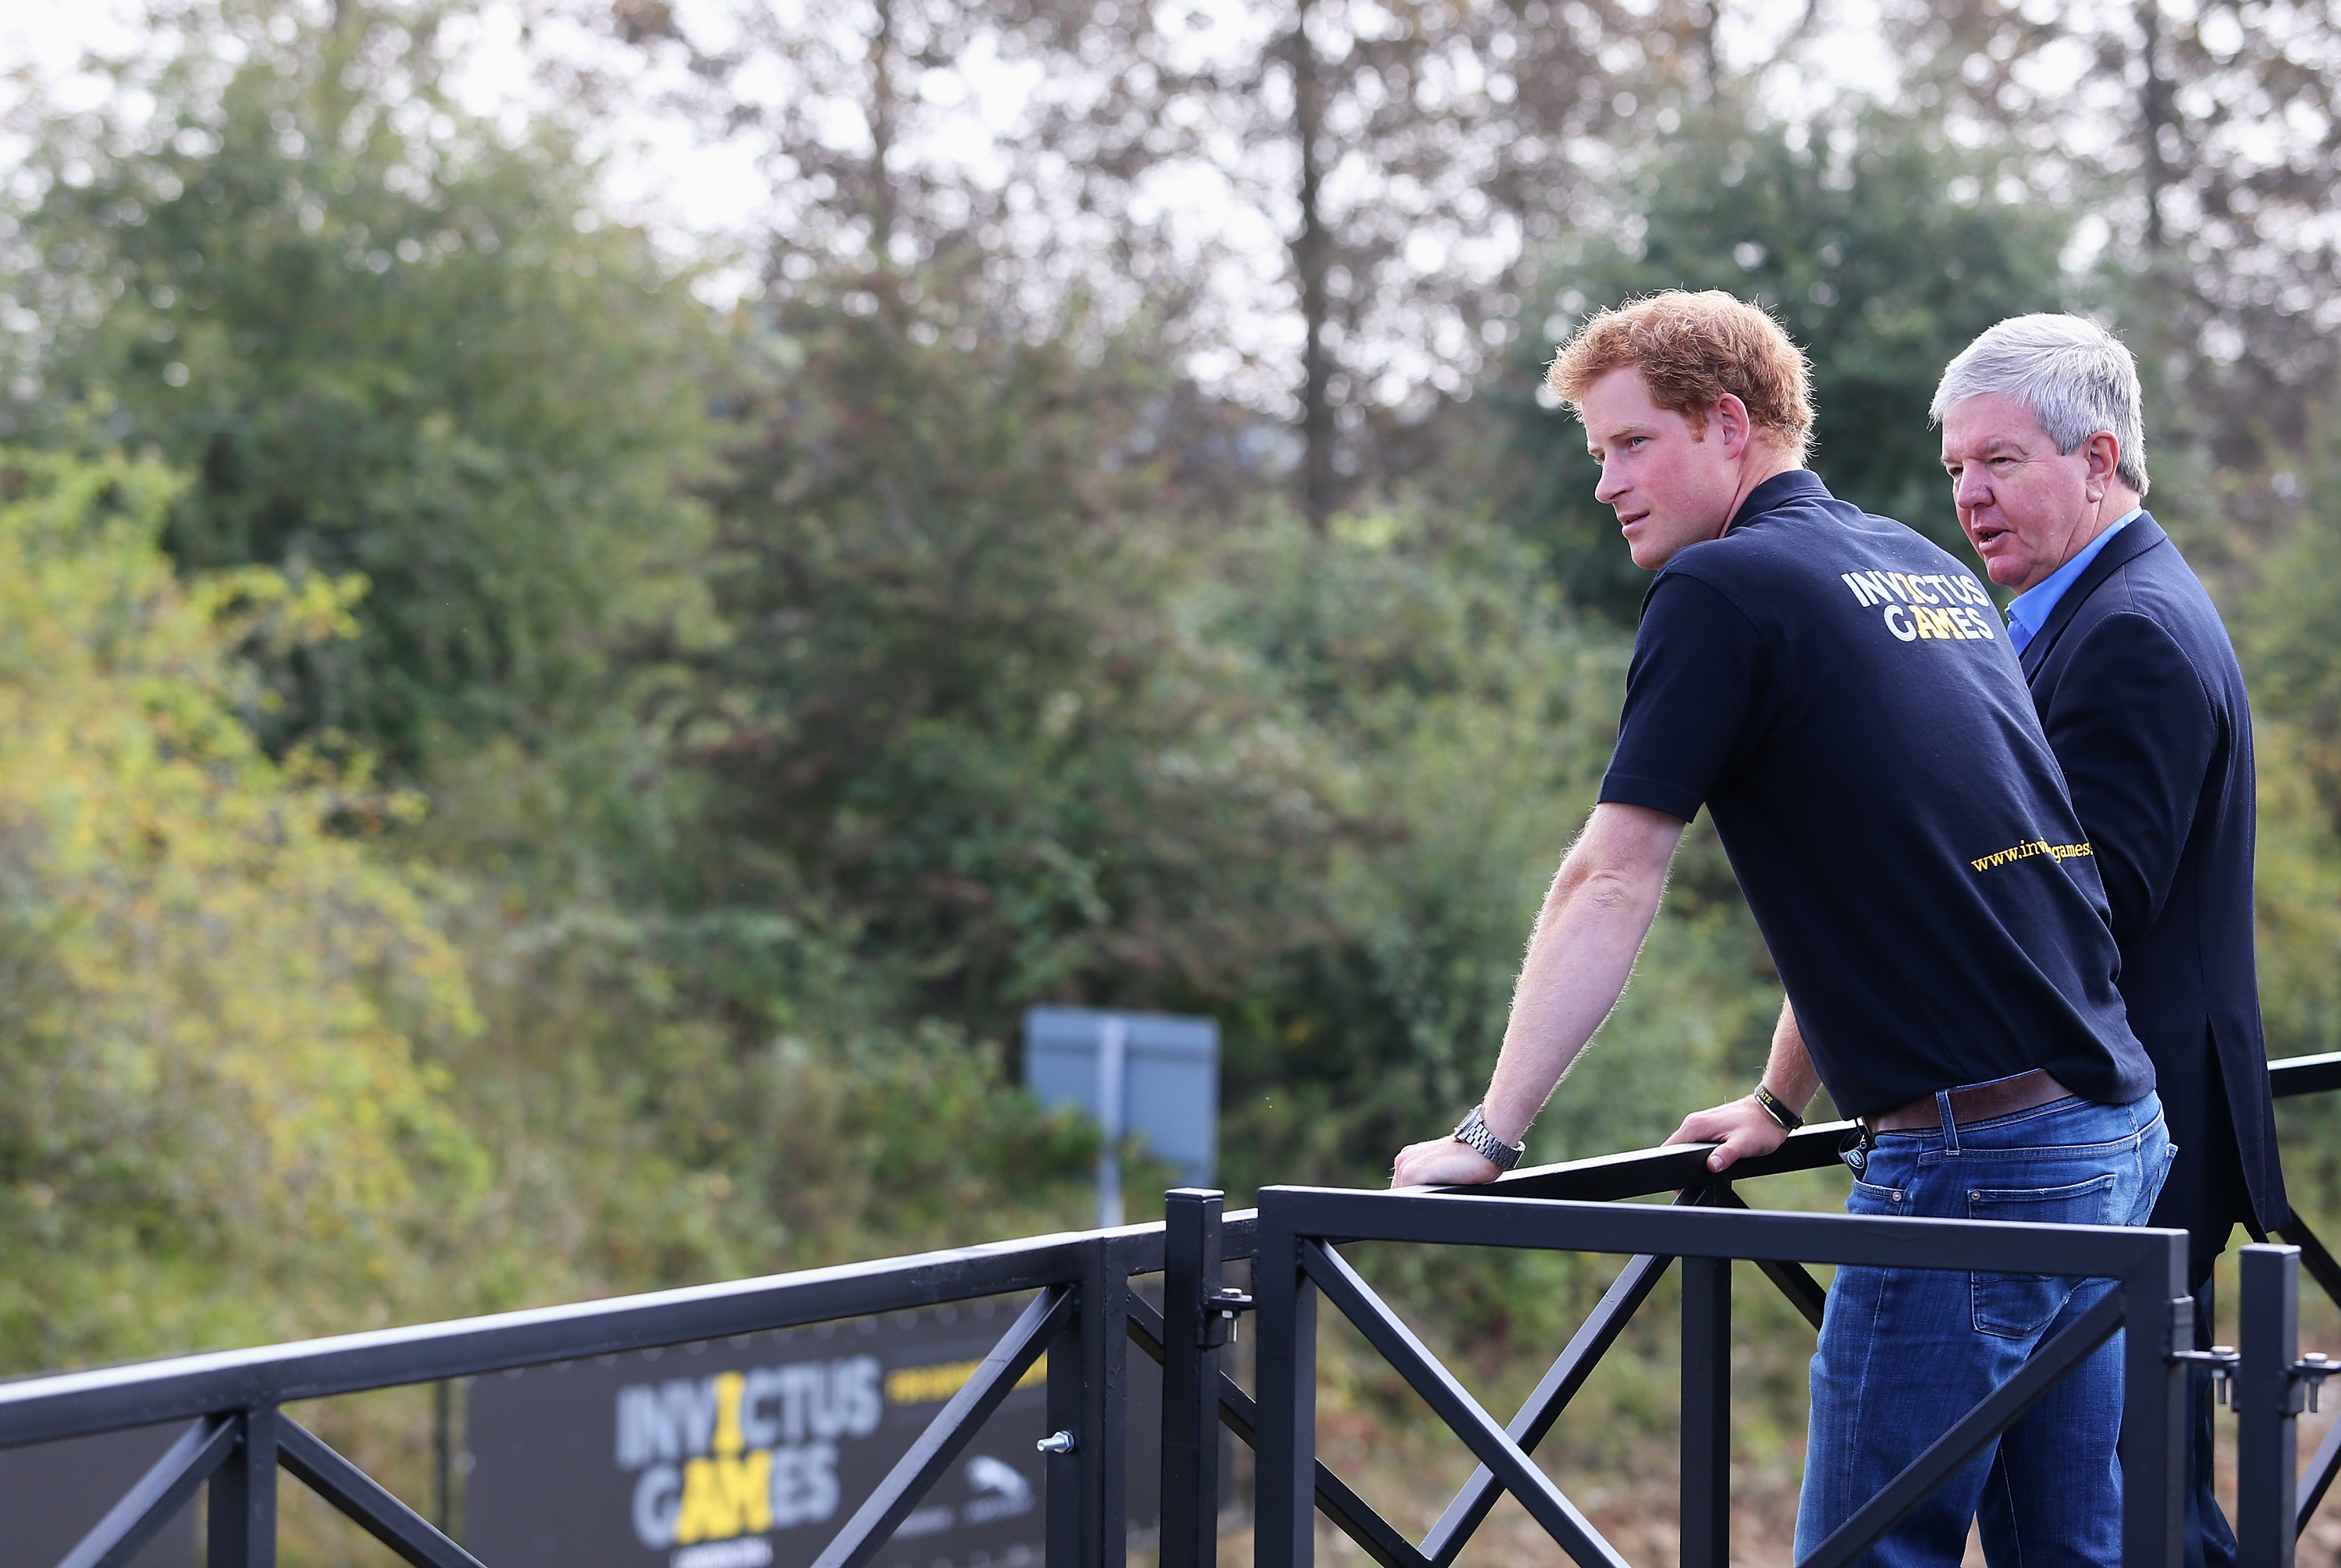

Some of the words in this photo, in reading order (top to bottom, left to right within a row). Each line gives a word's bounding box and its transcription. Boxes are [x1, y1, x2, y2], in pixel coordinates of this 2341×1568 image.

[1841, 570, 1989, 608] INVICTUS
[1884, 604, 1995, 642] GAMES
[616, 1354, 882, 1469] INVICTUS
[632, 1441, 839, 1550] GAMES
